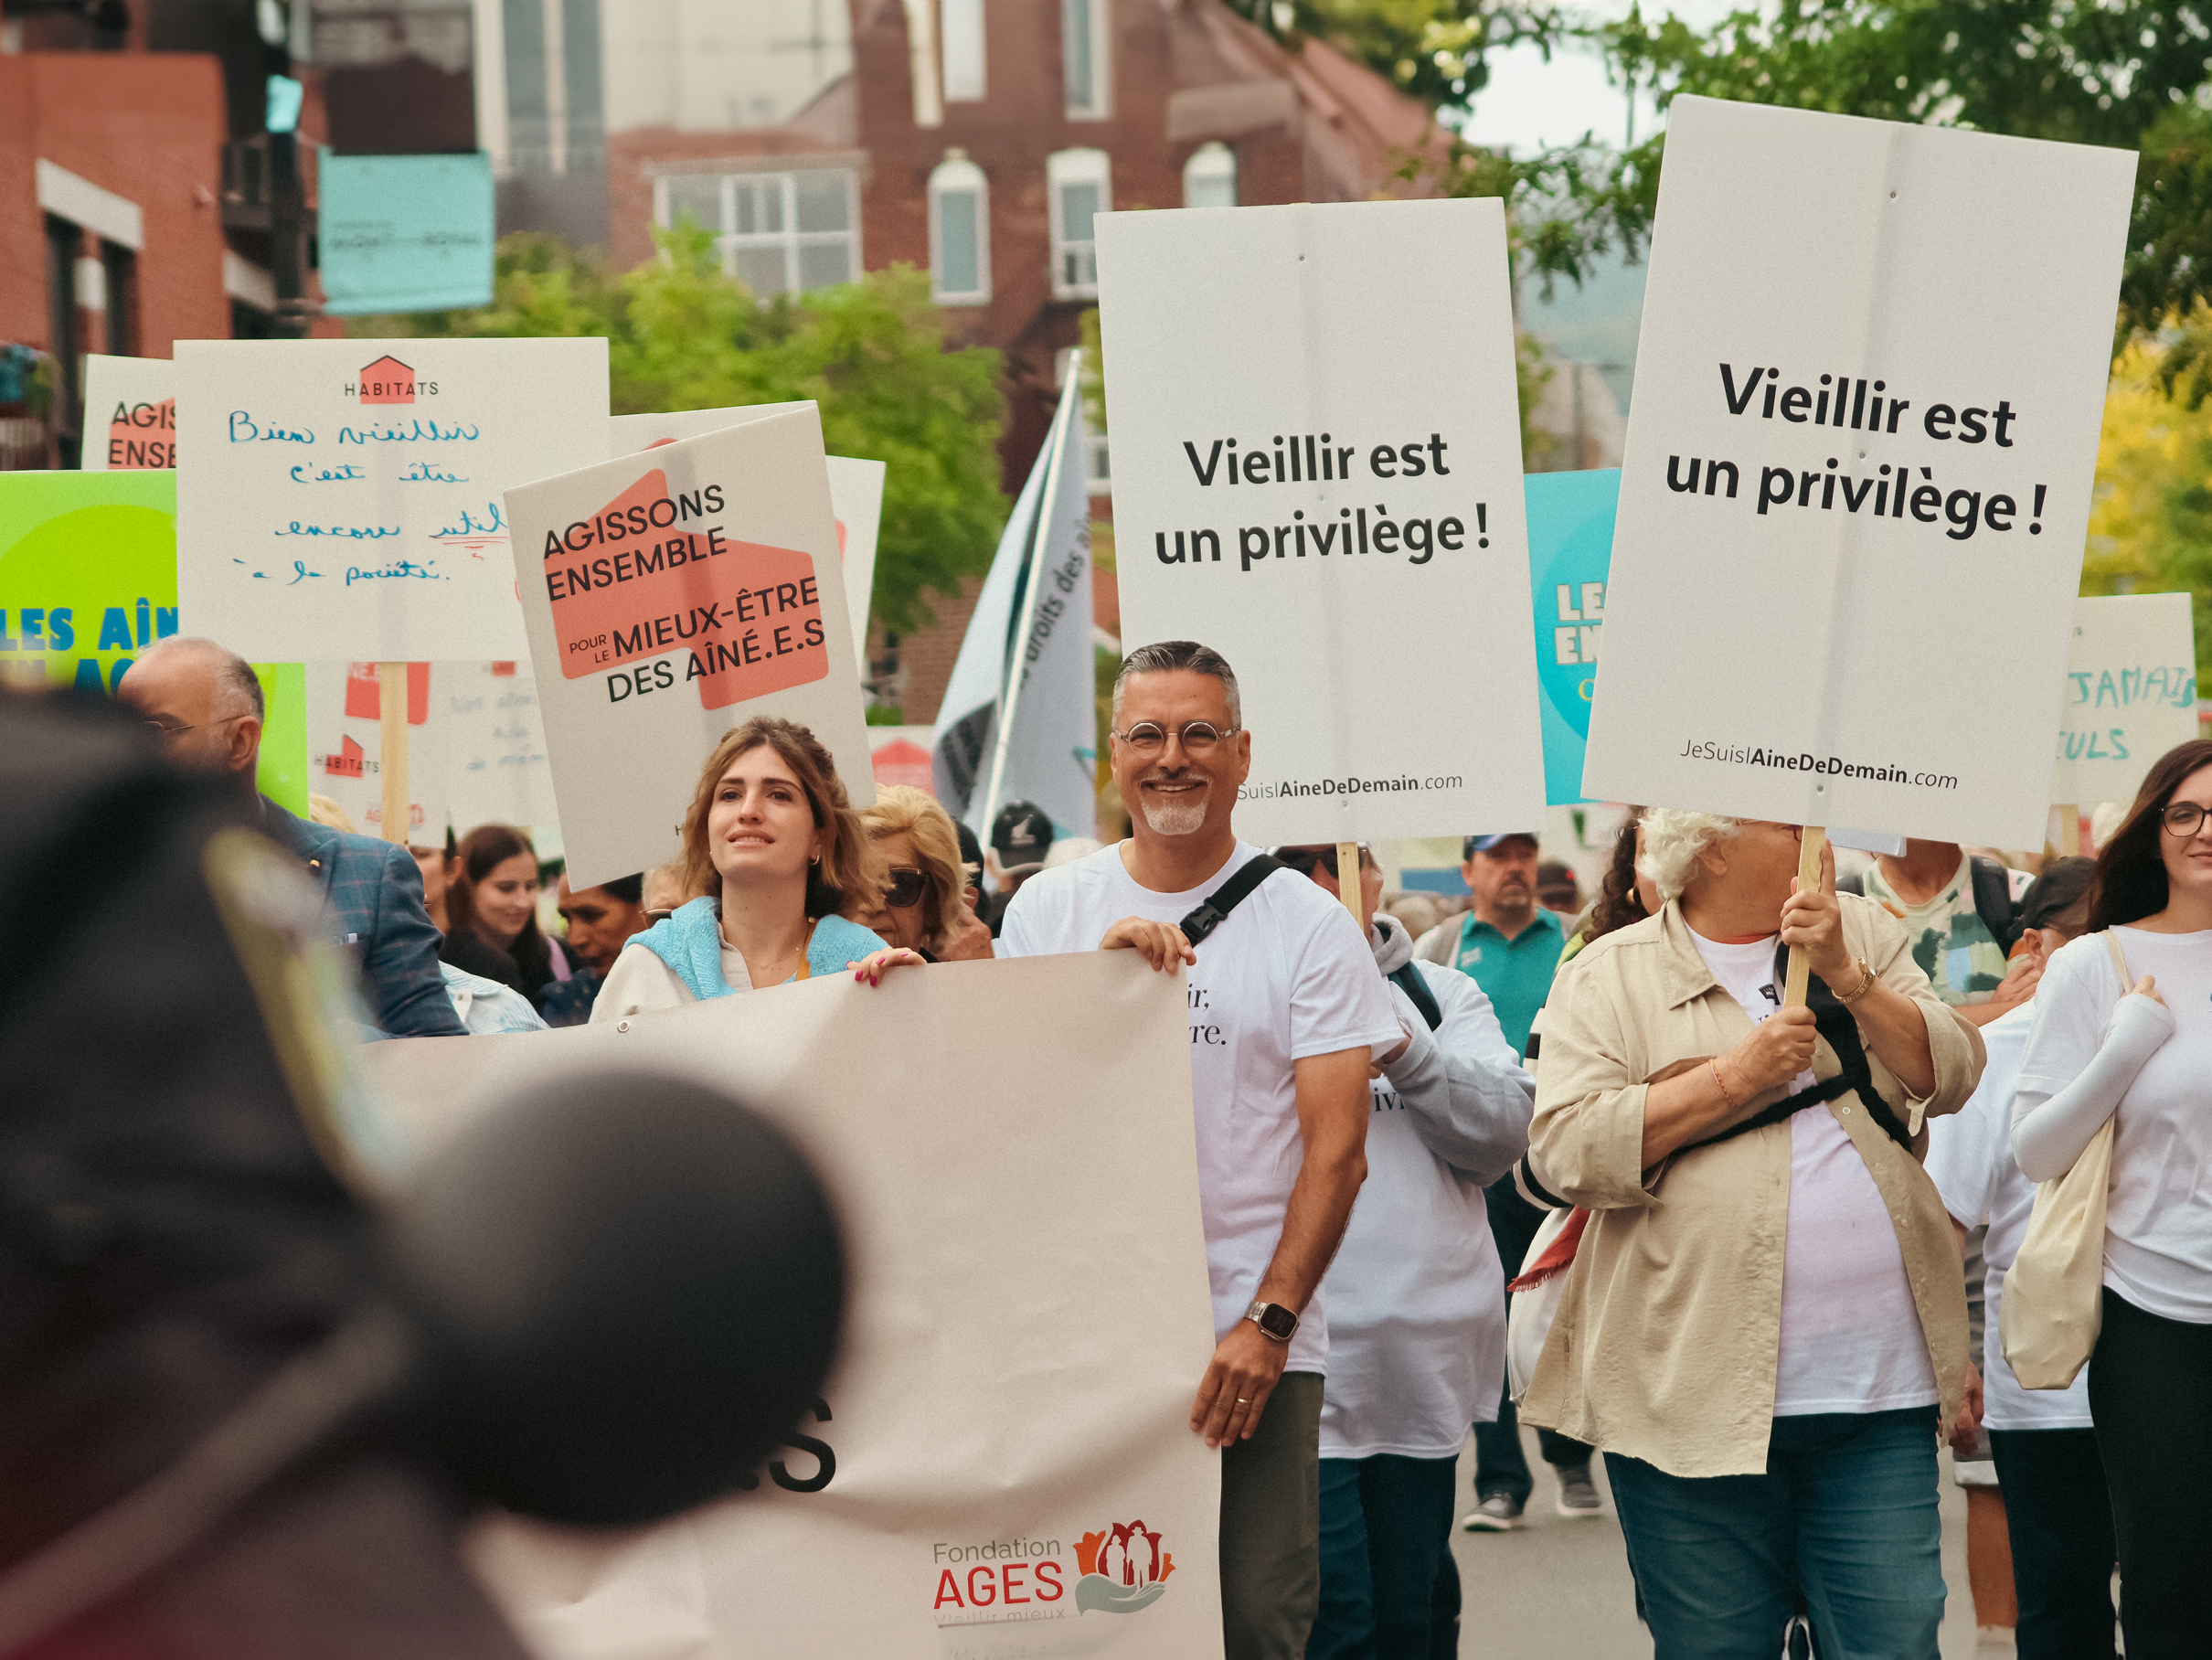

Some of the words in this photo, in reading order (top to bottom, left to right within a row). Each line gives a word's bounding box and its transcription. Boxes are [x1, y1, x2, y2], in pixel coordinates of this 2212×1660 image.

[344, 382, 440, 397] HABITATS
[1719, 362, 1910, 433] Vieillir
[1923, 400, 2017, 448] est
[229, 410, 315, 444] Bien
[339, 419, 480, 444] vieillir
[290, 462, 367, 484] c'est
[399, 462, 470, 484] être
[1183, 432, 1355, 486] Vieillir
[1370, 432, 1452, 479] est
[1666, 455, 1739, 498] un
[1757, 456, 2017, 540] privilège
[274, 521, 400, 539] encore
[544, 484, 726, 560] AGISSONS
[1155, 527, 1221, 564] un
[1239, 504, 1464, 571] privilège
[286, 559, 326, 586] la
[547, 527, 728, 601] ENSEMBLE
[1052, 550, 1086, 594] des
[594, 651, 610, 664] LE
[612, 576, 820, 657] MIEUX-ÊTRE
[1556, 580, 1608, 622] LE
[0, 606, 75, 652] LES
[569, 634, 607, 654] POUR
[607, 659, 675, 703] DES
[686, 619, 825, 682] AÎNÉ.E.S
[2068, 665, 2196, 708] JAMAIS
[314, 756, 379, 772] HABITATS
[2057, 729, 2131, 761] ULS
[1189, 1025, 1227, 1046] re.
[1374, 1087, 1405, 1112] iv
[933, 1537, 1061, 1564] Fondation
[933, 1561, 1064, 1610] AGES
[1007, 1607, 1066, 1623] mieux
